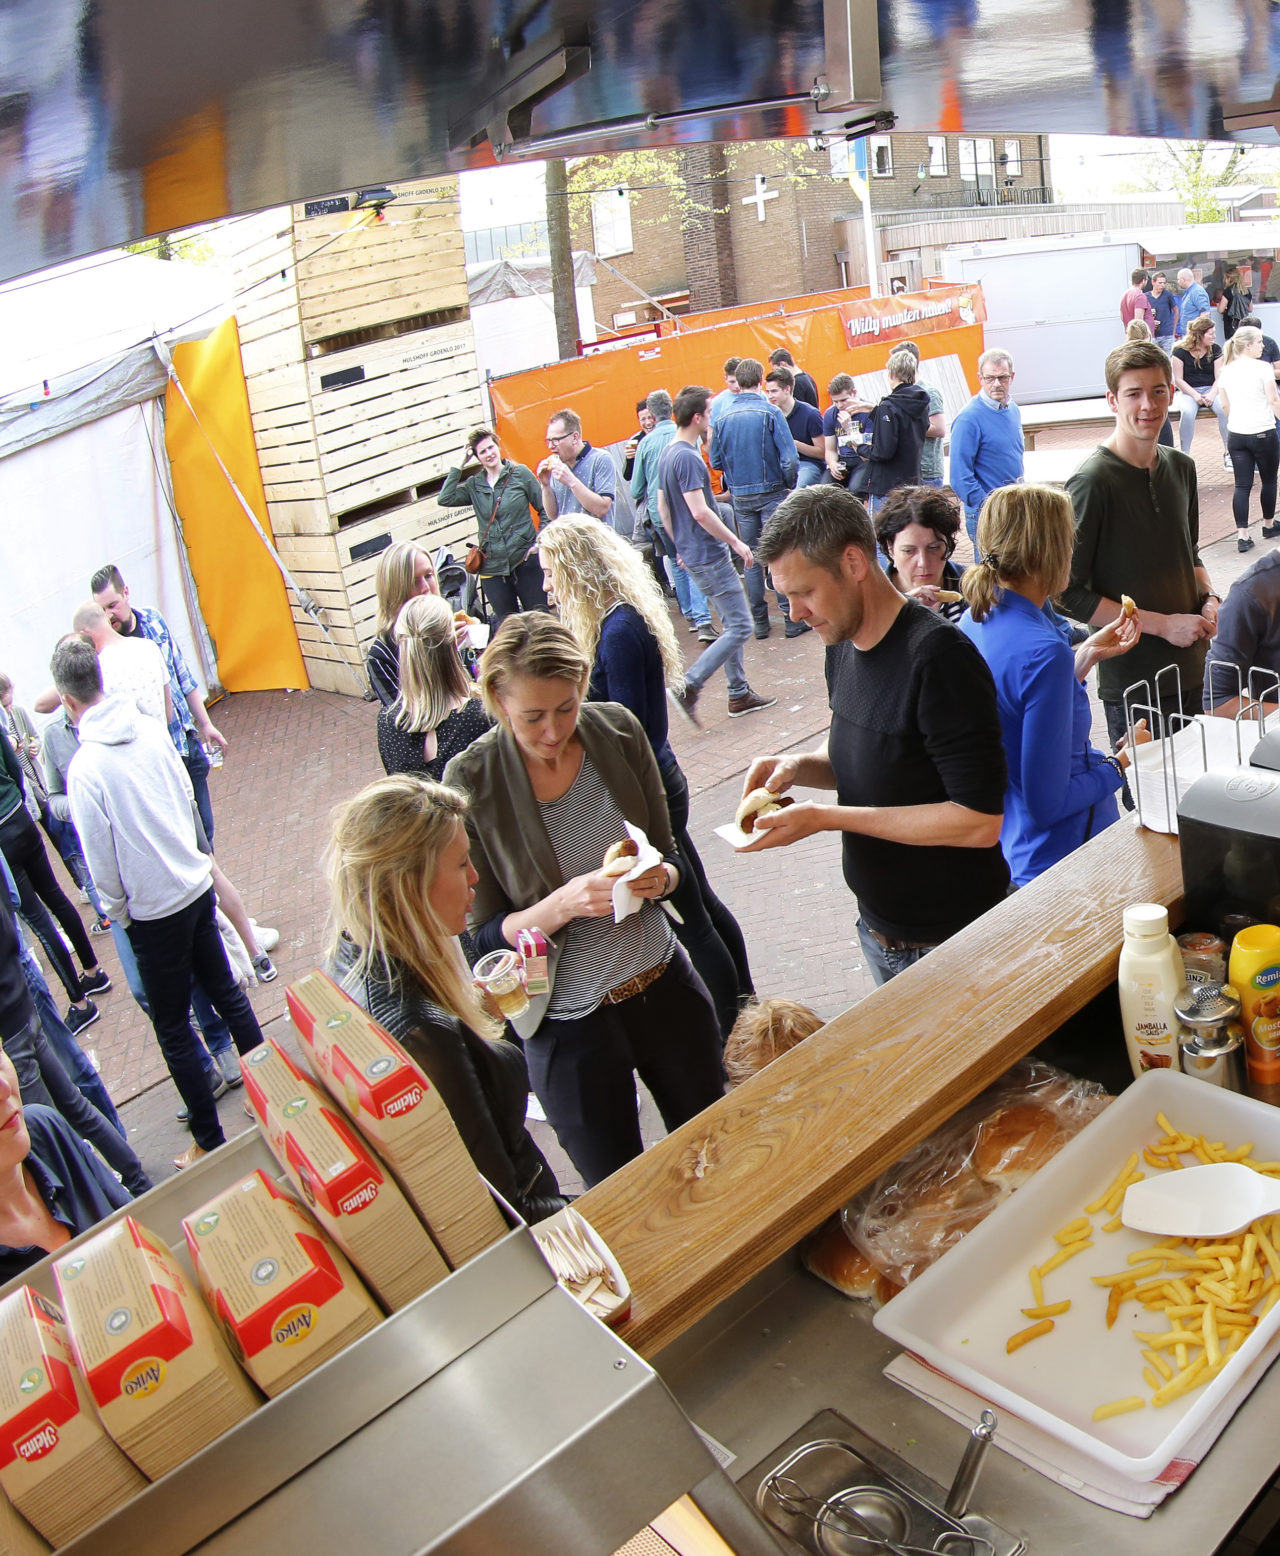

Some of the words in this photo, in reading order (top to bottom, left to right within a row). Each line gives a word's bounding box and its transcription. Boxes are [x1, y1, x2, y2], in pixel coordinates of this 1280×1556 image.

[398, 190, 414, 198] SHOFF
[848, 317, 881, 337] Willy
[882, 309, 920, 328] munten
[429, 346, 454, 357] GROENLO
[454, 343, 466, 351] 2017
[454, 507, 473, 517] GROENL
[1185, 973, 1204, 982] EINZ
[1135, 1022, 1168, 1031] JAMBALLA
[386, 1088, 423, 1117] Heinz
[342, 1183, 378, 1213] Heinz
[275, 1309, 313, 1345] Aviko
[124, 1362, 161, 1396] Aviko
[19, 1426, 58, 1458] Heinz
